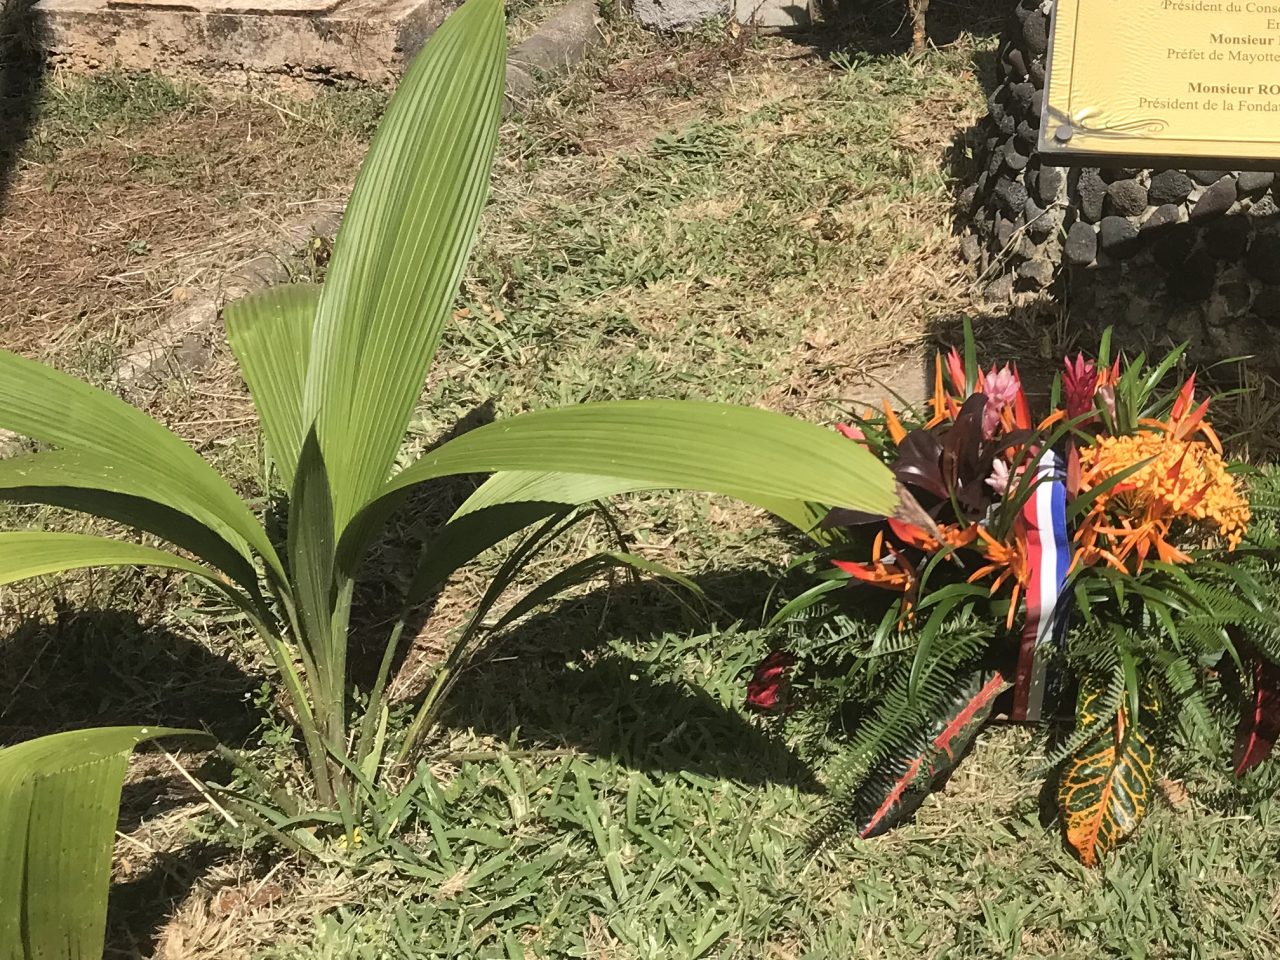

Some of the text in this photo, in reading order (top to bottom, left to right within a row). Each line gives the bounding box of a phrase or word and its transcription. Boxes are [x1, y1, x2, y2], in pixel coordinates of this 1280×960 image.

[1163, 0, 1222, 12] Président
[1226, 1, 1242, 12] du
[1210, 33, 1274, 46] Monsieur
[1167, 48, 1205, 60] Préfet
[1209, 49, 1224, 60] de
[1188, 82, 1254, 95] Monsieur
[1139, 97, 1199, 110] Président
[1203, 99, 1218, 110] de
[1223, 100, 1234, 111] la
